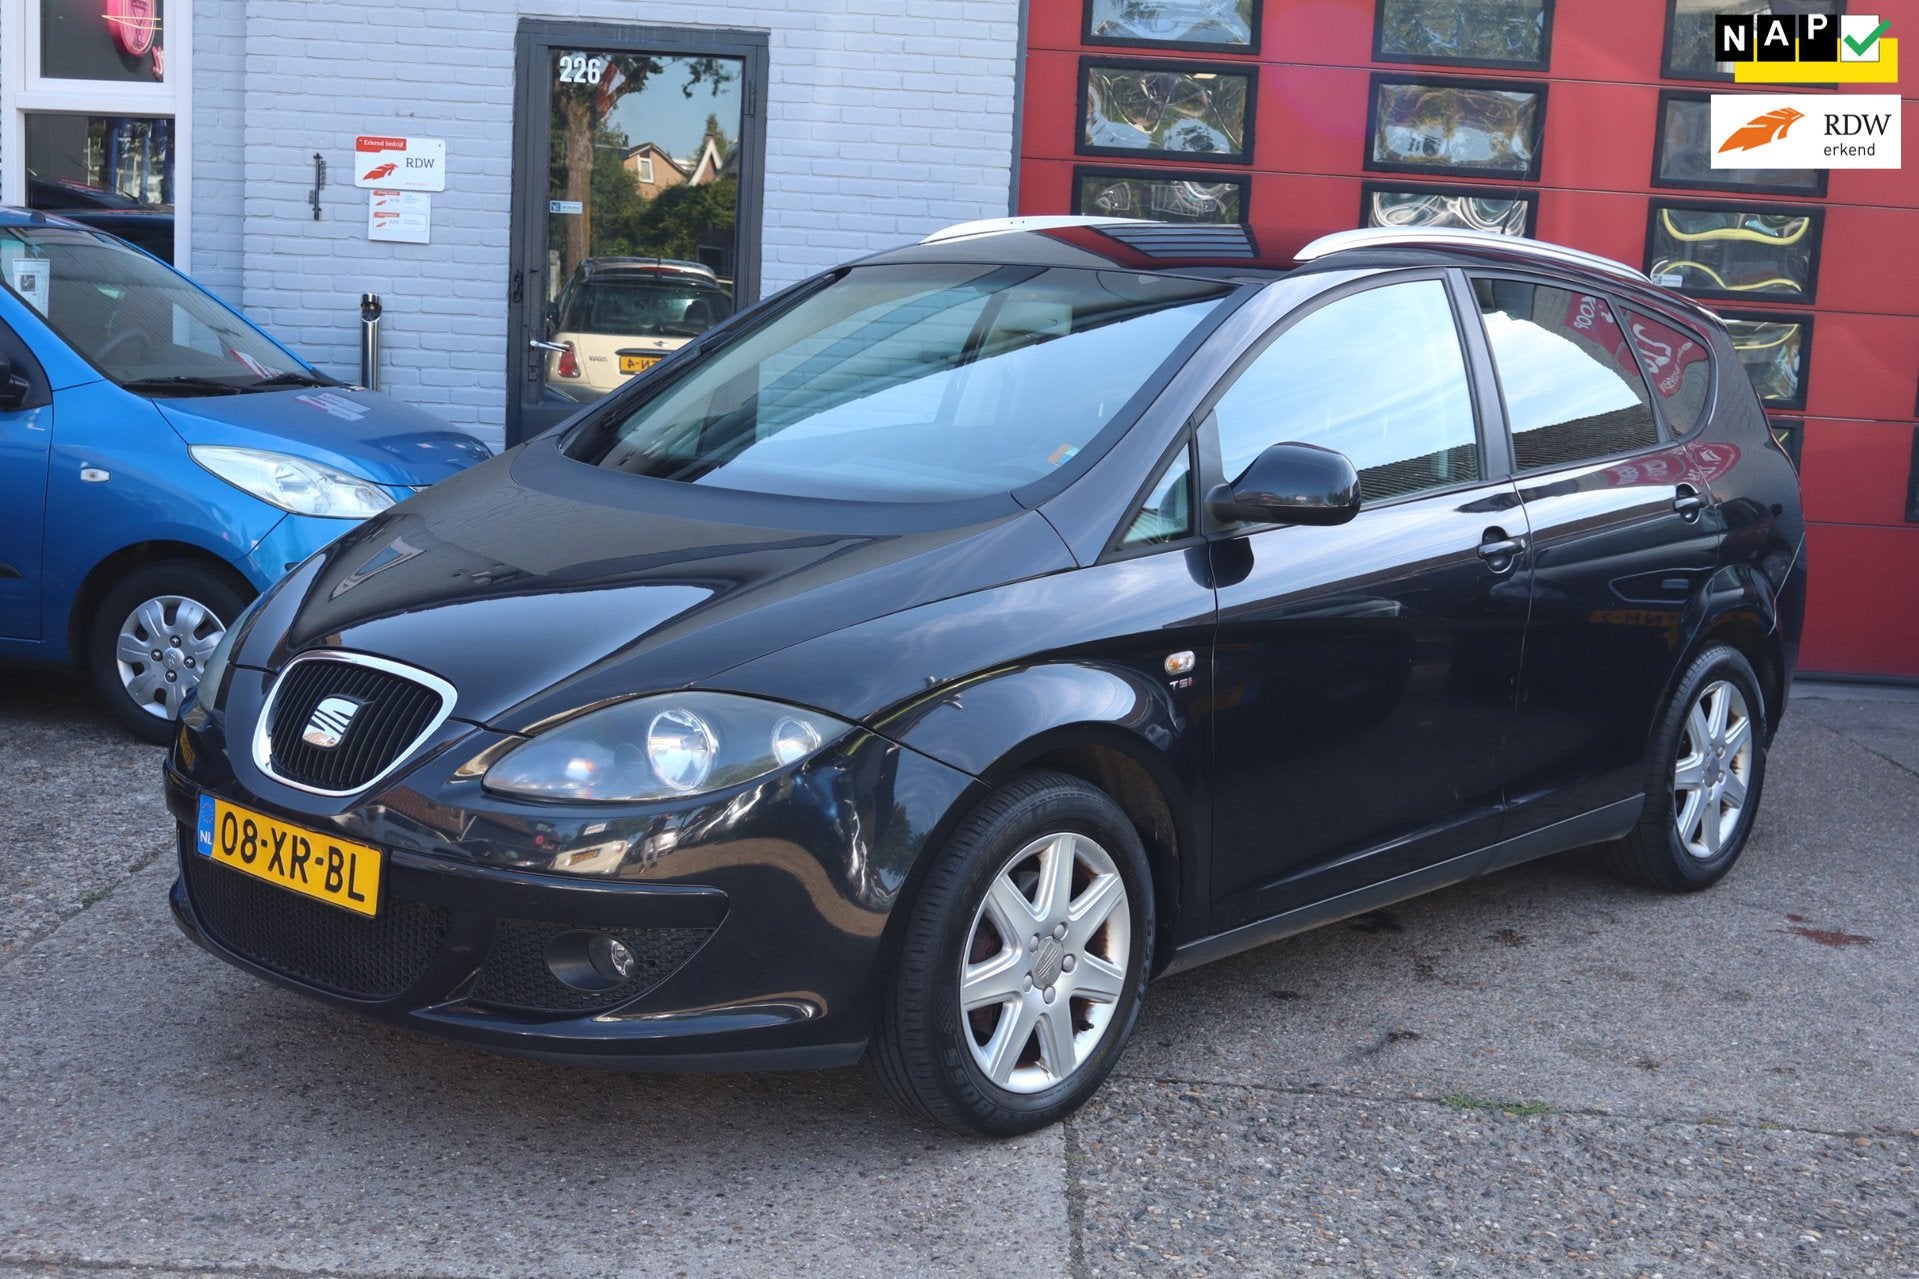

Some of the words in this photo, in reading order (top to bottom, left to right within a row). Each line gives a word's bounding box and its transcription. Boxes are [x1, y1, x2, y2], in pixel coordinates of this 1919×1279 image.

[559, 56, 601, 84] 226
[405, 157, 435, 169] RDW
[200, 830, 212, 846] NL
[221, 811, 365, 902] 08-XR-BL
